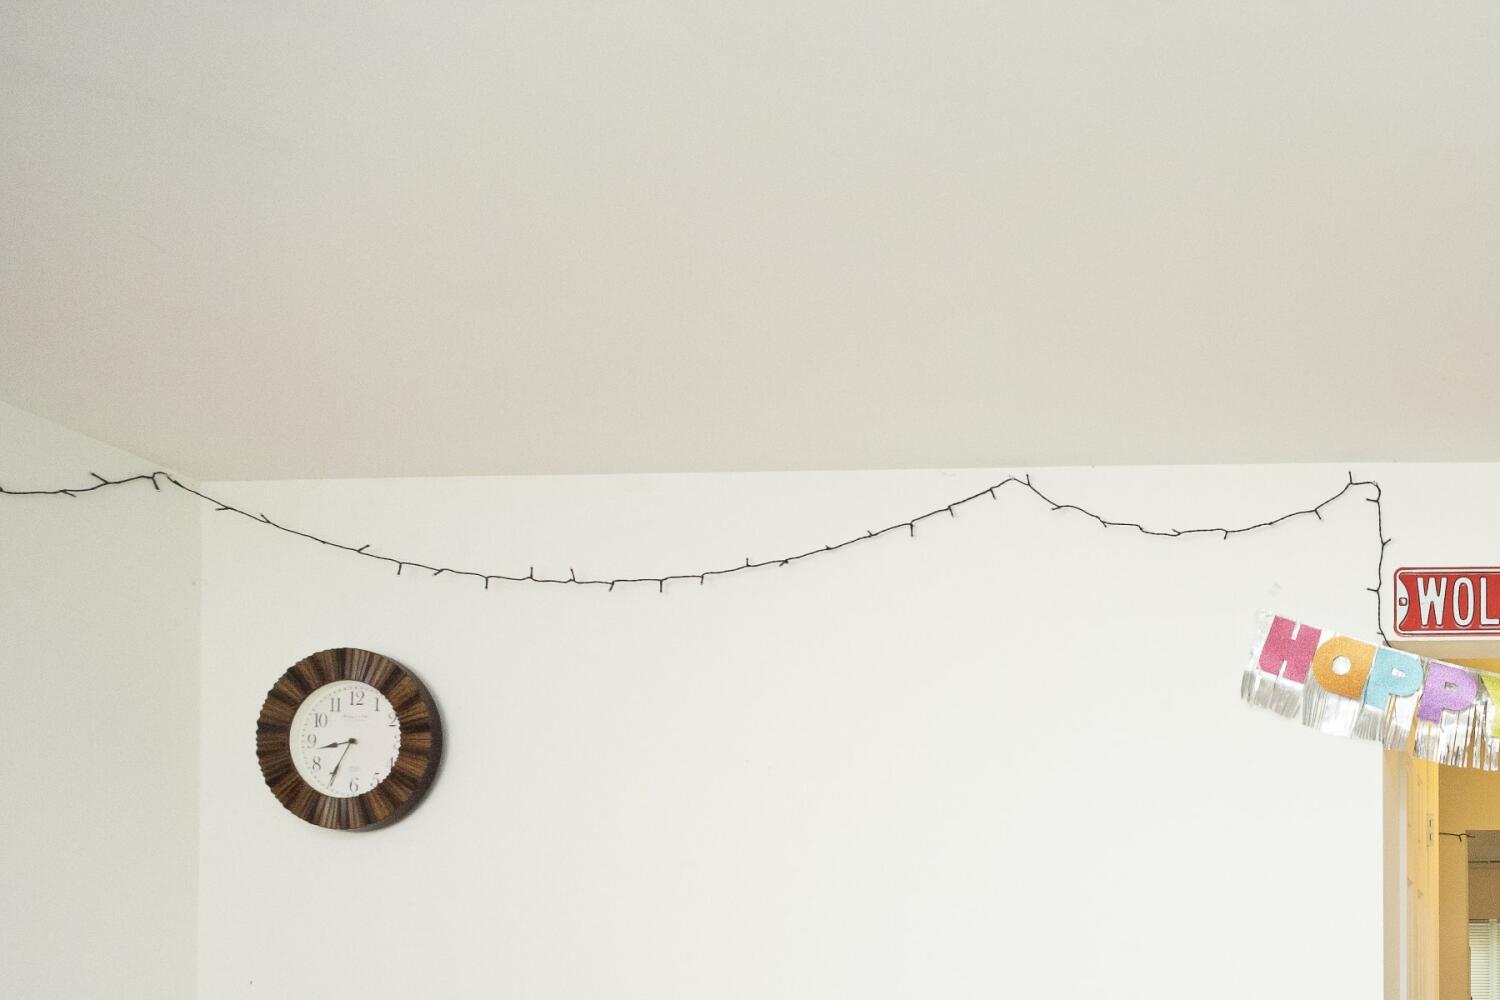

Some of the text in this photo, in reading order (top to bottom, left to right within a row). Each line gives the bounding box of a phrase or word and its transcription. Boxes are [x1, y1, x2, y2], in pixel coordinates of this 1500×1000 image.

[329, 697, 341, 712] 11
[349, 690, 365, 706] 12
[314, 712, 328, 728] 10
[307, 733, 317, 749] 9
[312, 756, 322, 771] 8
[349, 777, 359, 793] 6
